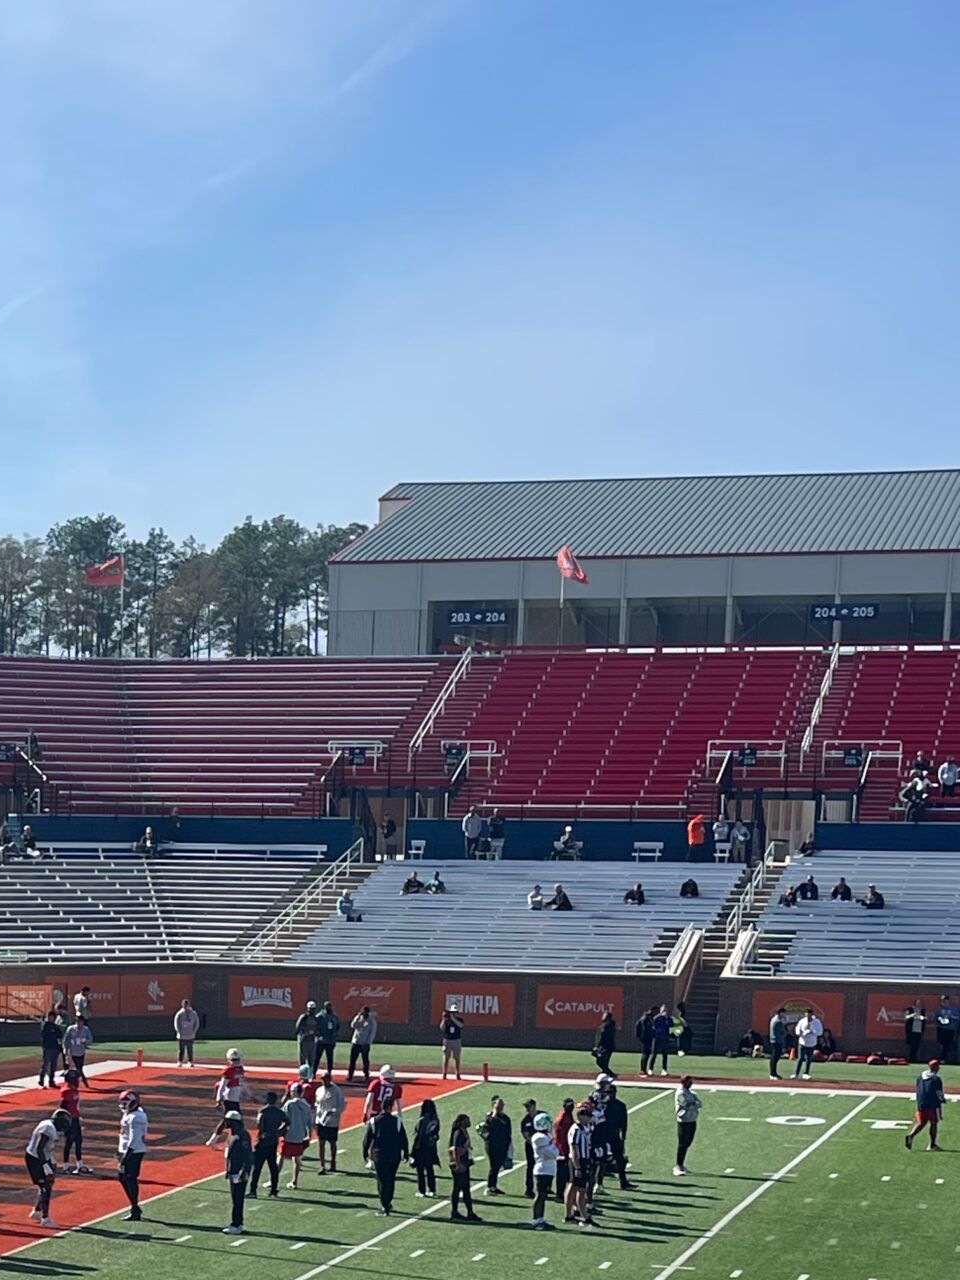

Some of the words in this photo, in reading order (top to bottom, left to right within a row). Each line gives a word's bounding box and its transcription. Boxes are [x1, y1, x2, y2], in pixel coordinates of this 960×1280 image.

[450, 612, 471, 623] 203
[485, 611, 506, 622] 204
[814, 607, 837, 618] 204
[852, 606, 875, 617] 205
[464, 995, 499, 1014] NFLPA
[555, 1001, 614, 1014] CATAPULT
